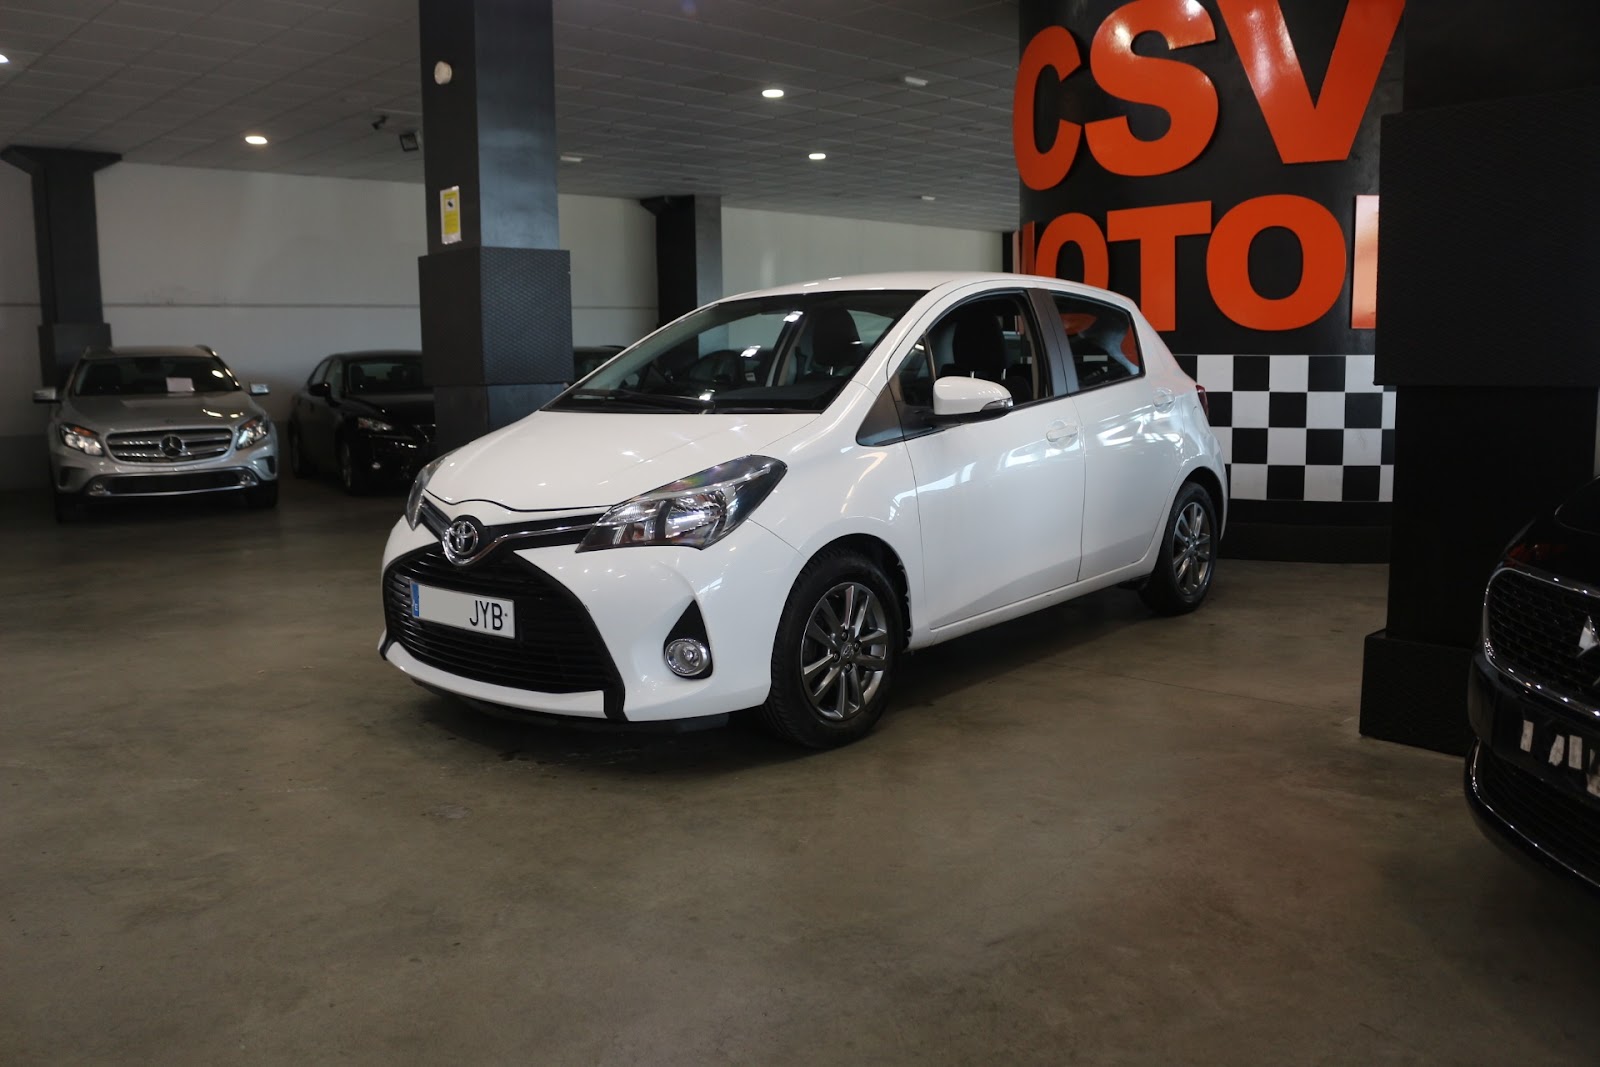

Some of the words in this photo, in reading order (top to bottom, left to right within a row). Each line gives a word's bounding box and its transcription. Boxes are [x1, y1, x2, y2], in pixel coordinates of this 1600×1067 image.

[1013, 0, 1405, 190] CSV
[1012, 194, 1380, 331] OTO
[469, 600, 503, 630] JYB
